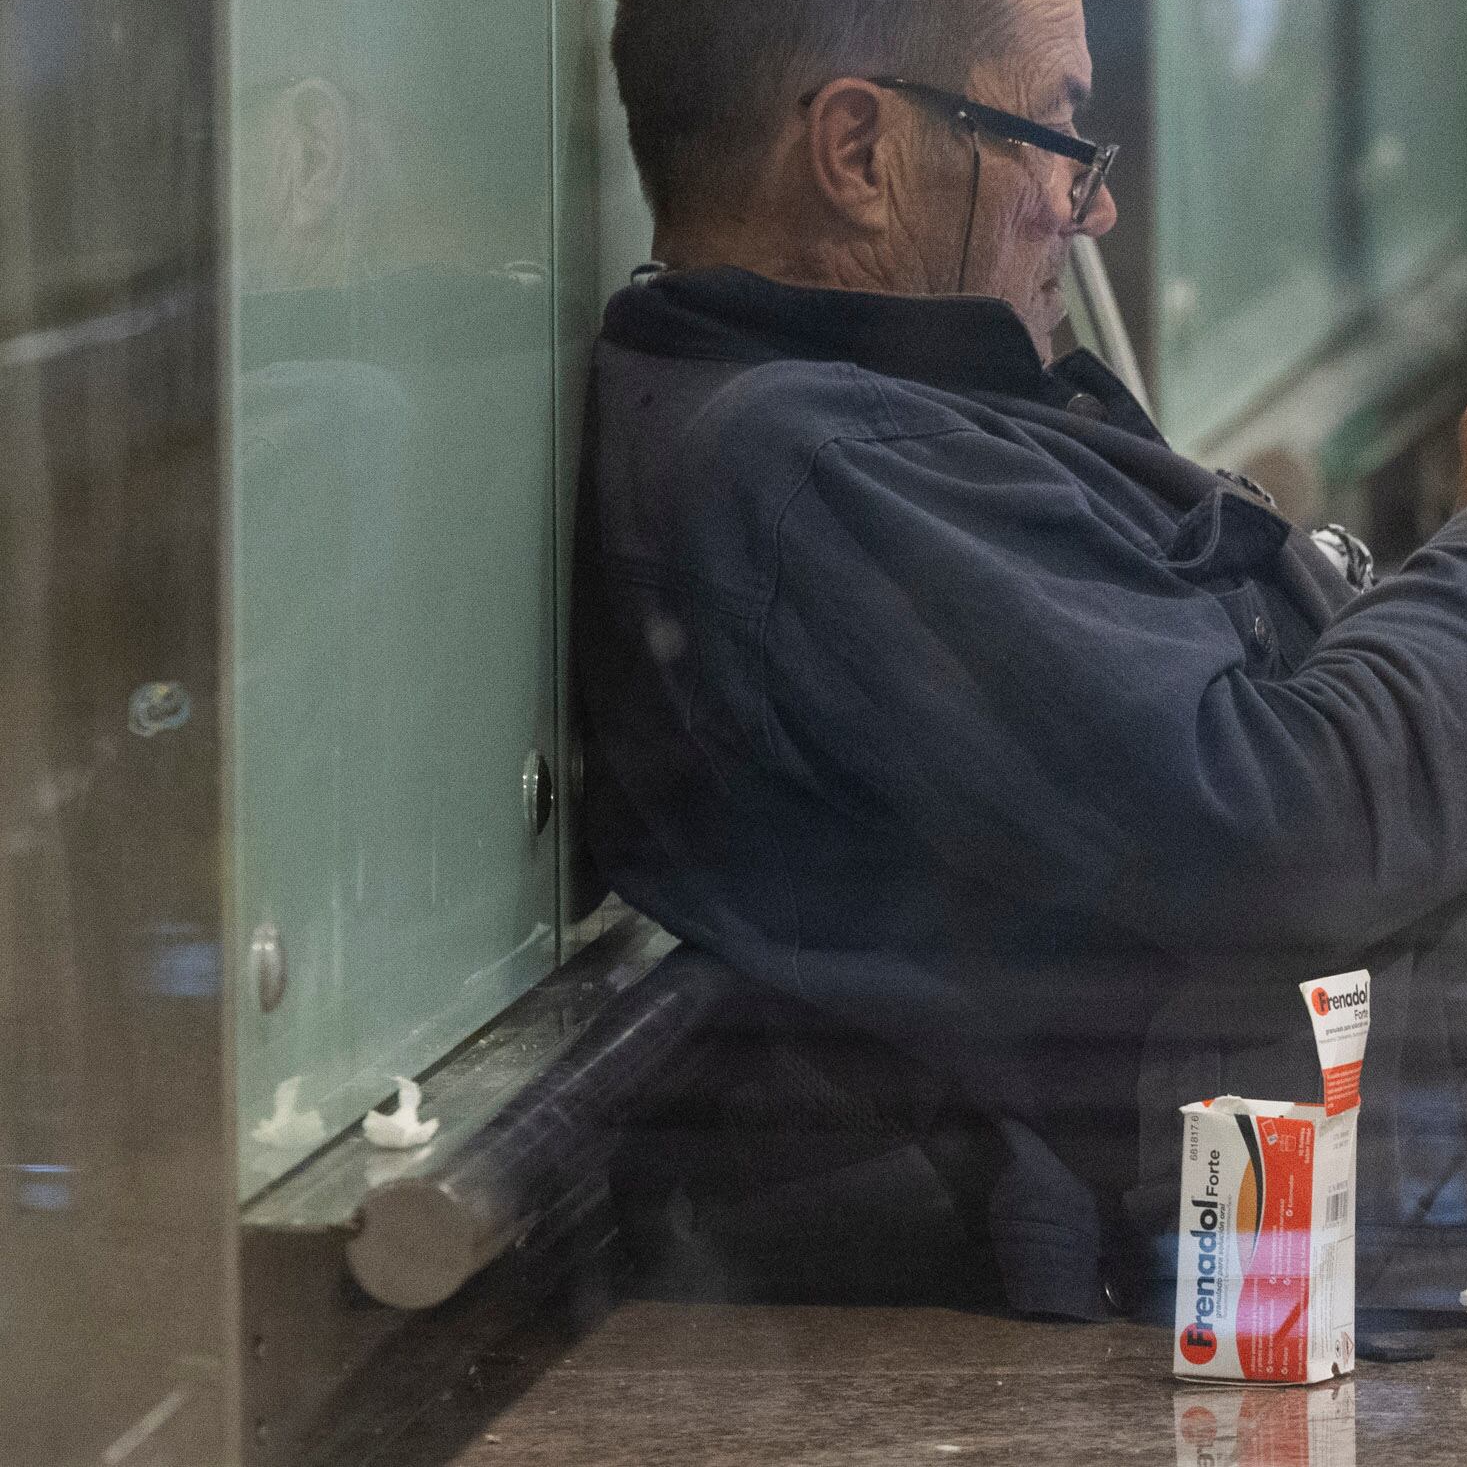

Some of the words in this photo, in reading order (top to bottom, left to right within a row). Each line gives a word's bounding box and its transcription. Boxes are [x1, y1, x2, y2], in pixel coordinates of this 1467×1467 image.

[1318, 981, 1368, 1012] Frenadol
[1186, 1200, 1217, 1347] Frenadol
[1206, 1150, 1220, 1196] Forte
